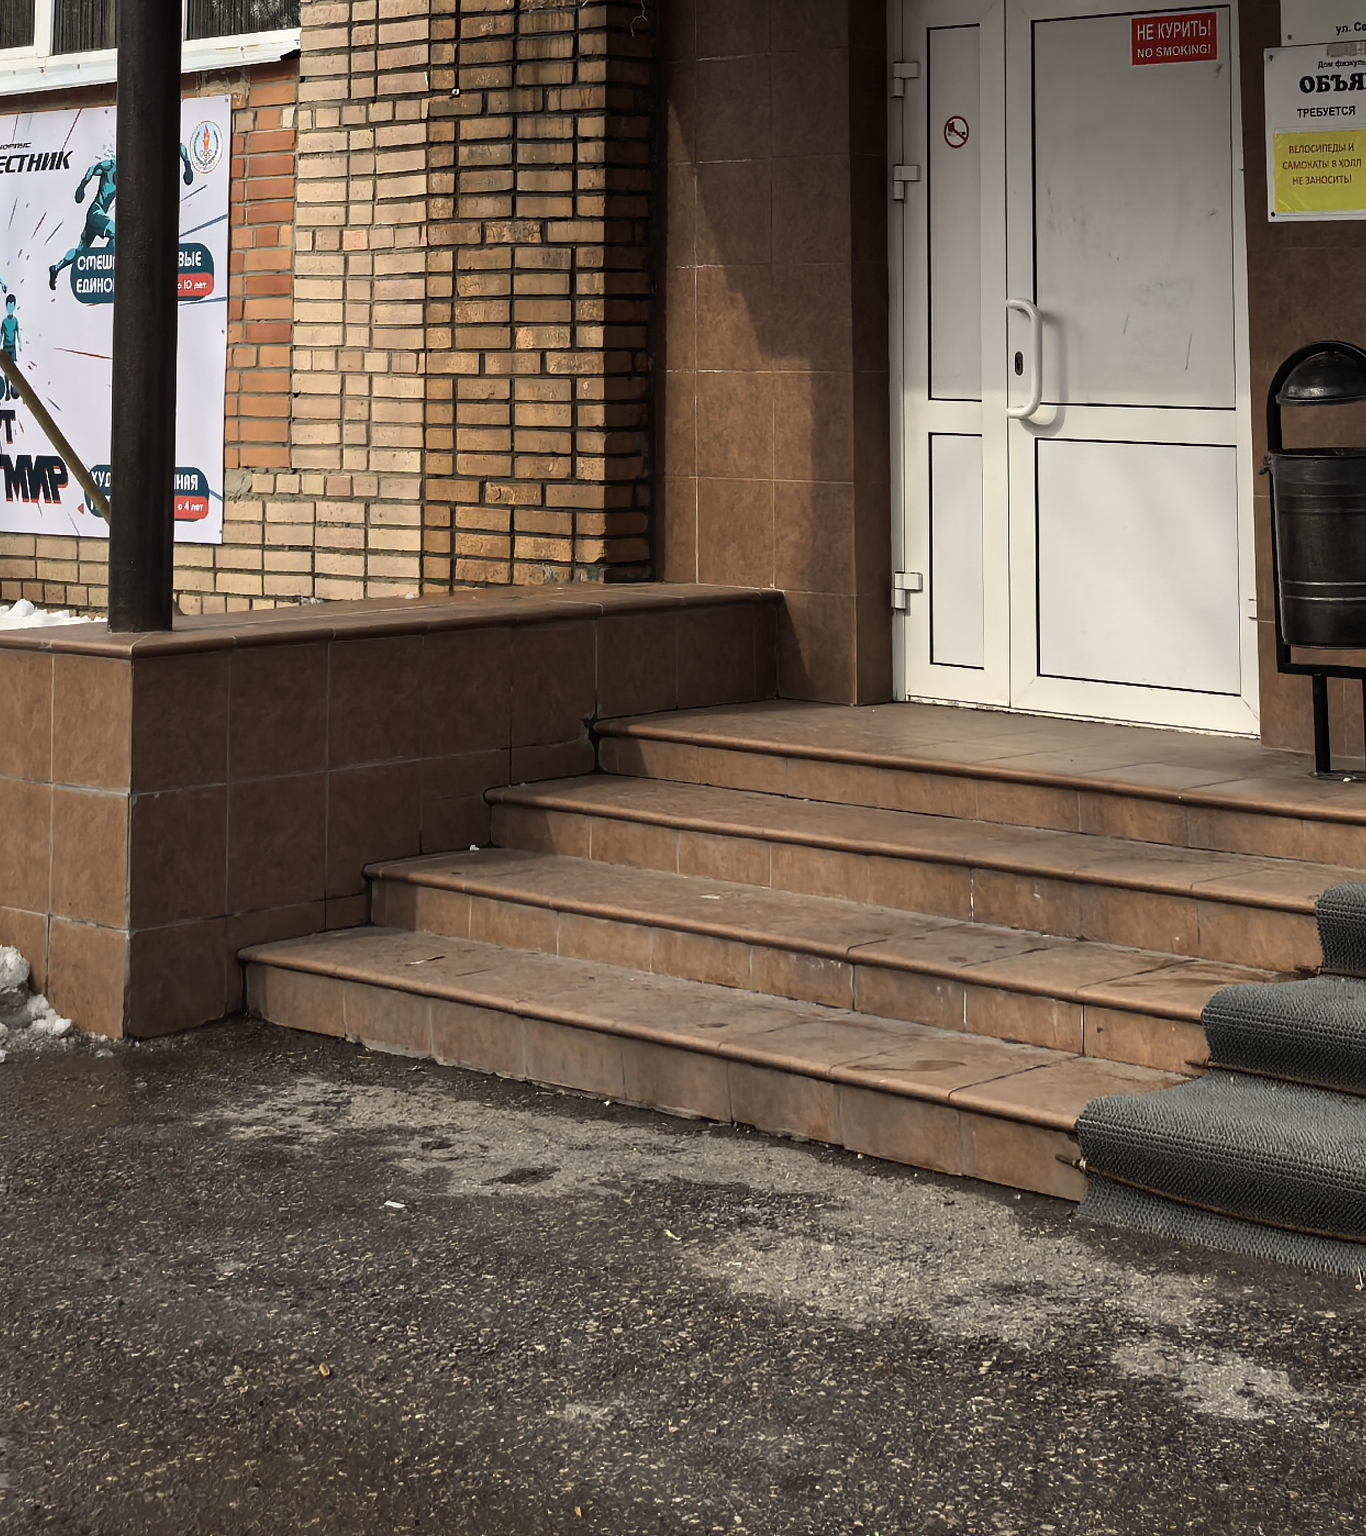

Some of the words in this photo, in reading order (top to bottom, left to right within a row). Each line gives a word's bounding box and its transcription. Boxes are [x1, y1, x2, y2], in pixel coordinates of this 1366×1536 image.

[1137, 24, 1154, 41] НЕ
[1158, 19, 1212, 39] КУРИТЬ!
[1336, 23, 1351, 35] ул.
[1137, 48, 1153, 58] NO
[1156, 44, 1211, 57] SMOKING!
[1318, 60, 1334, 69] Дом
[1297, 106, 1356, 118] ТРЕБУЕТСЯ
[1288, 143, 1347, 155] ВЕЛОСИПЕДЫ
[1282, 159, 1330, 170] САМОКАТЫ
[1339, 158, 1362, 169] ХОЛЛ
[1292, 177, 1304, 185] НЕ
[77, 254, 115, 270] СМЕШ
[178, 251, 202, 267] ВЫЕ
[76, 277, 115, 293] ЕДИНО
[184, 279, 192, 290] 10
[0, 454, 69, 505] МИР
[174, 474, 198, 490] НАЯ
[184, 500, 190, 510] 4
